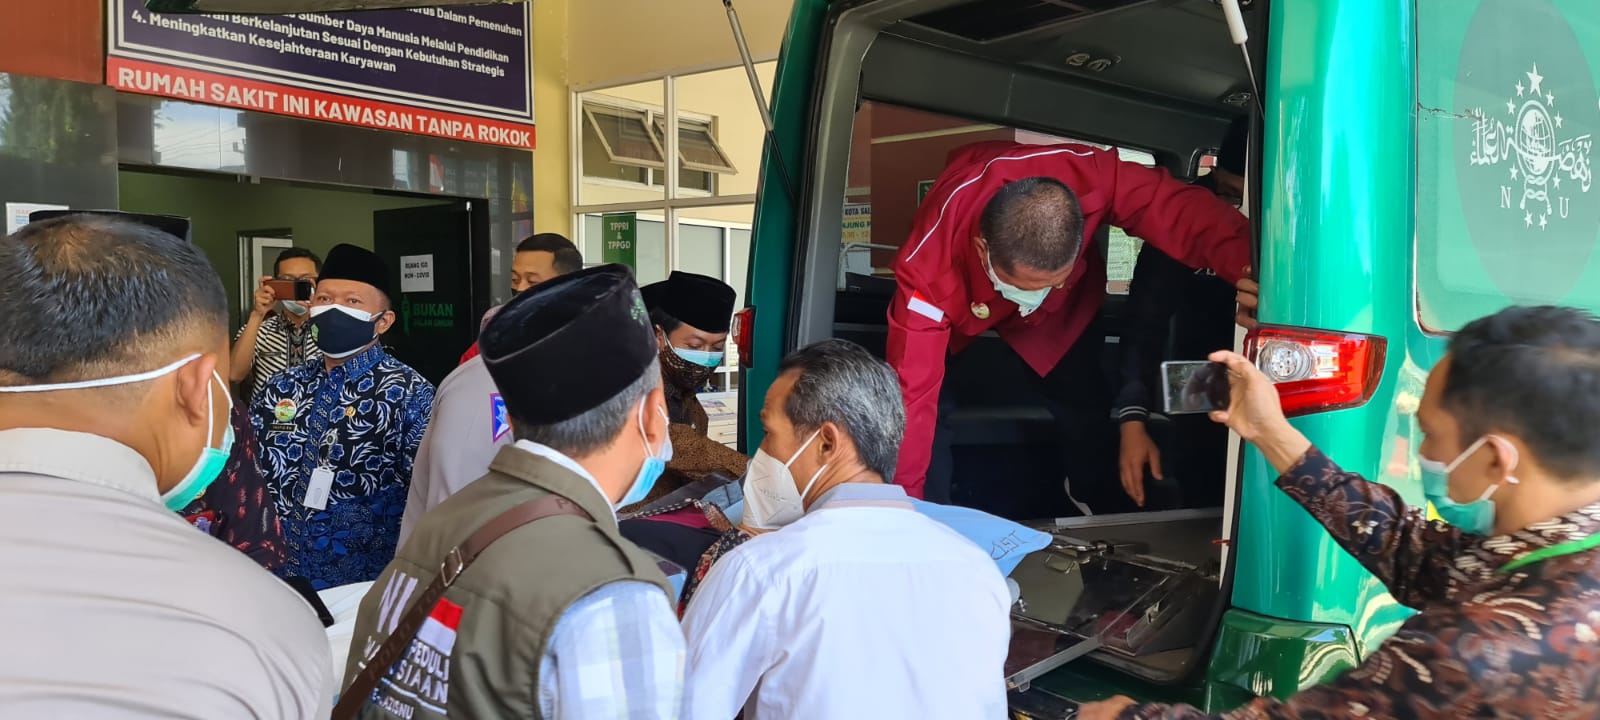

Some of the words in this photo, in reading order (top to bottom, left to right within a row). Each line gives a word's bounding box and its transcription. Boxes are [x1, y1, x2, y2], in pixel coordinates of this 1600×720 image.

[131, 9, 147, 23] 4.
[149, 12, 246, 43] Meningkatkan
[249, 33, 339, 62] Kesejahteraan
[341, 53, 397, 73] Karyawan
[232, 14, 320, 41] Berkelanjutan
[322, 31, 361, 49] Sesuai
[363, 40, 403, 57] Dengan
[405, 48, 460, 68] Kebutuhan
[461, 60, 505, 78] Strategis
[298, 13, 345, 29] Sumber
[346, 19, 374, 36] Daya
[376, 26, 420, 45] Manusia
[421, 34, 456, 52] Melalui
[457, 43, 509, 63] Pendidikan
[437, 7, 467, 25] Dalam
[469, 15, 523, 37] Pemenuhan
[118, 67, 205, 99] RUMAH
[210, 83, 278, 110] SAKIT
[283, 94, 310, 116] INI
[314, 99, 413, 132] KAWASAN
[416, 115, 474, 140] TANPA
[478, 124, 531, 147] ROKOK
[1500, 186, 1512, 208] N
[1558, 197, 1570, 218] U
[413, 303, 453, 317] BUKAN
